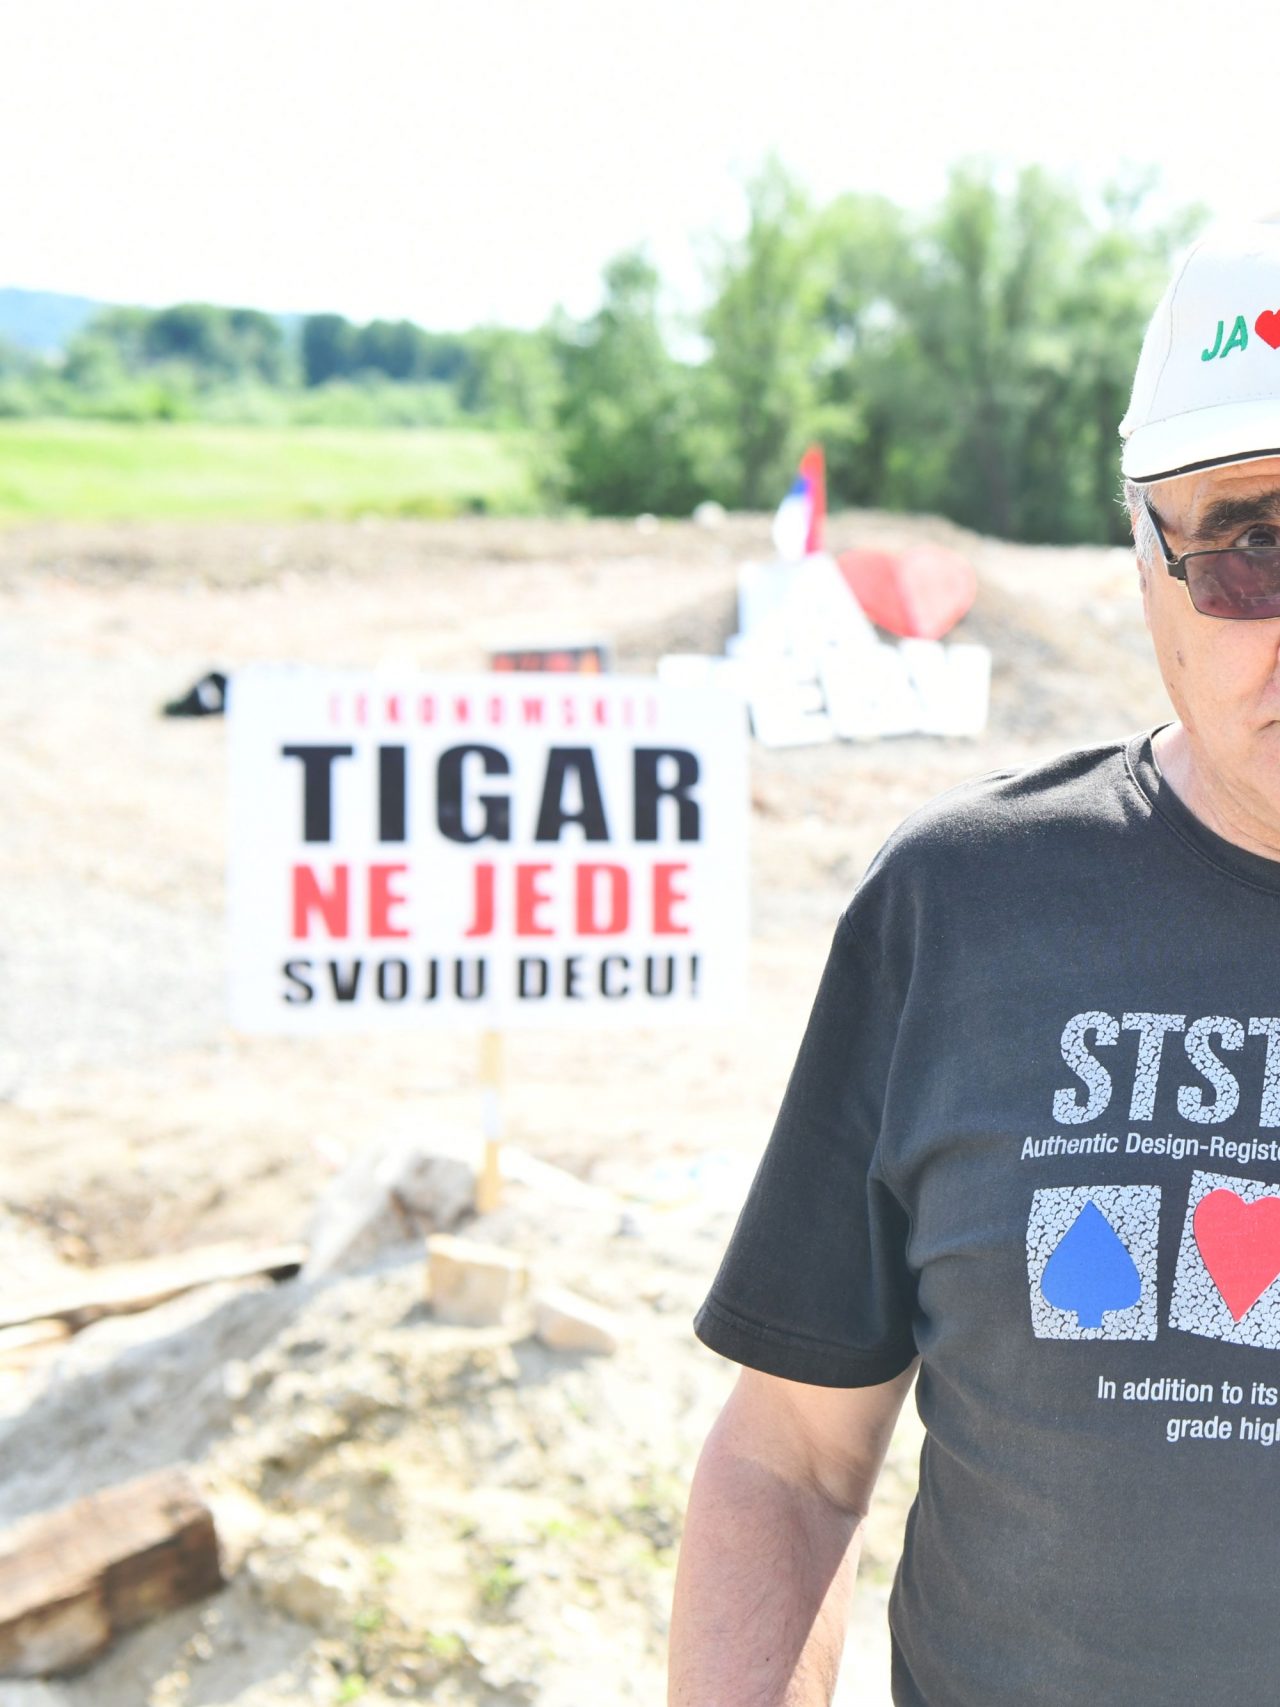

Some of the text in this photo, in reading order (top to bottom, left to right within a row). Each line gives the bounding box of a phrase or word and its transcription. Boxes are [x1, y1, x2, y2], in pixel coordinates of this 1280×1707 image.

[281, 744, 702, 843] TIGAR
[291, 862, 692, 940] NE JEDE
[283, 955, 701, 1004] SVOJU DECU!
[1021, 1133, 1120, 1161] Authentic
[1097, 1375, 1117, 1400] In
[1122, 1377, 1214, 1403] addition
[1220, 1380, 1244, 1405] to
[1250, 1381, 1279, 1406] its
[1166, 1415, 1233, 1443] grade
